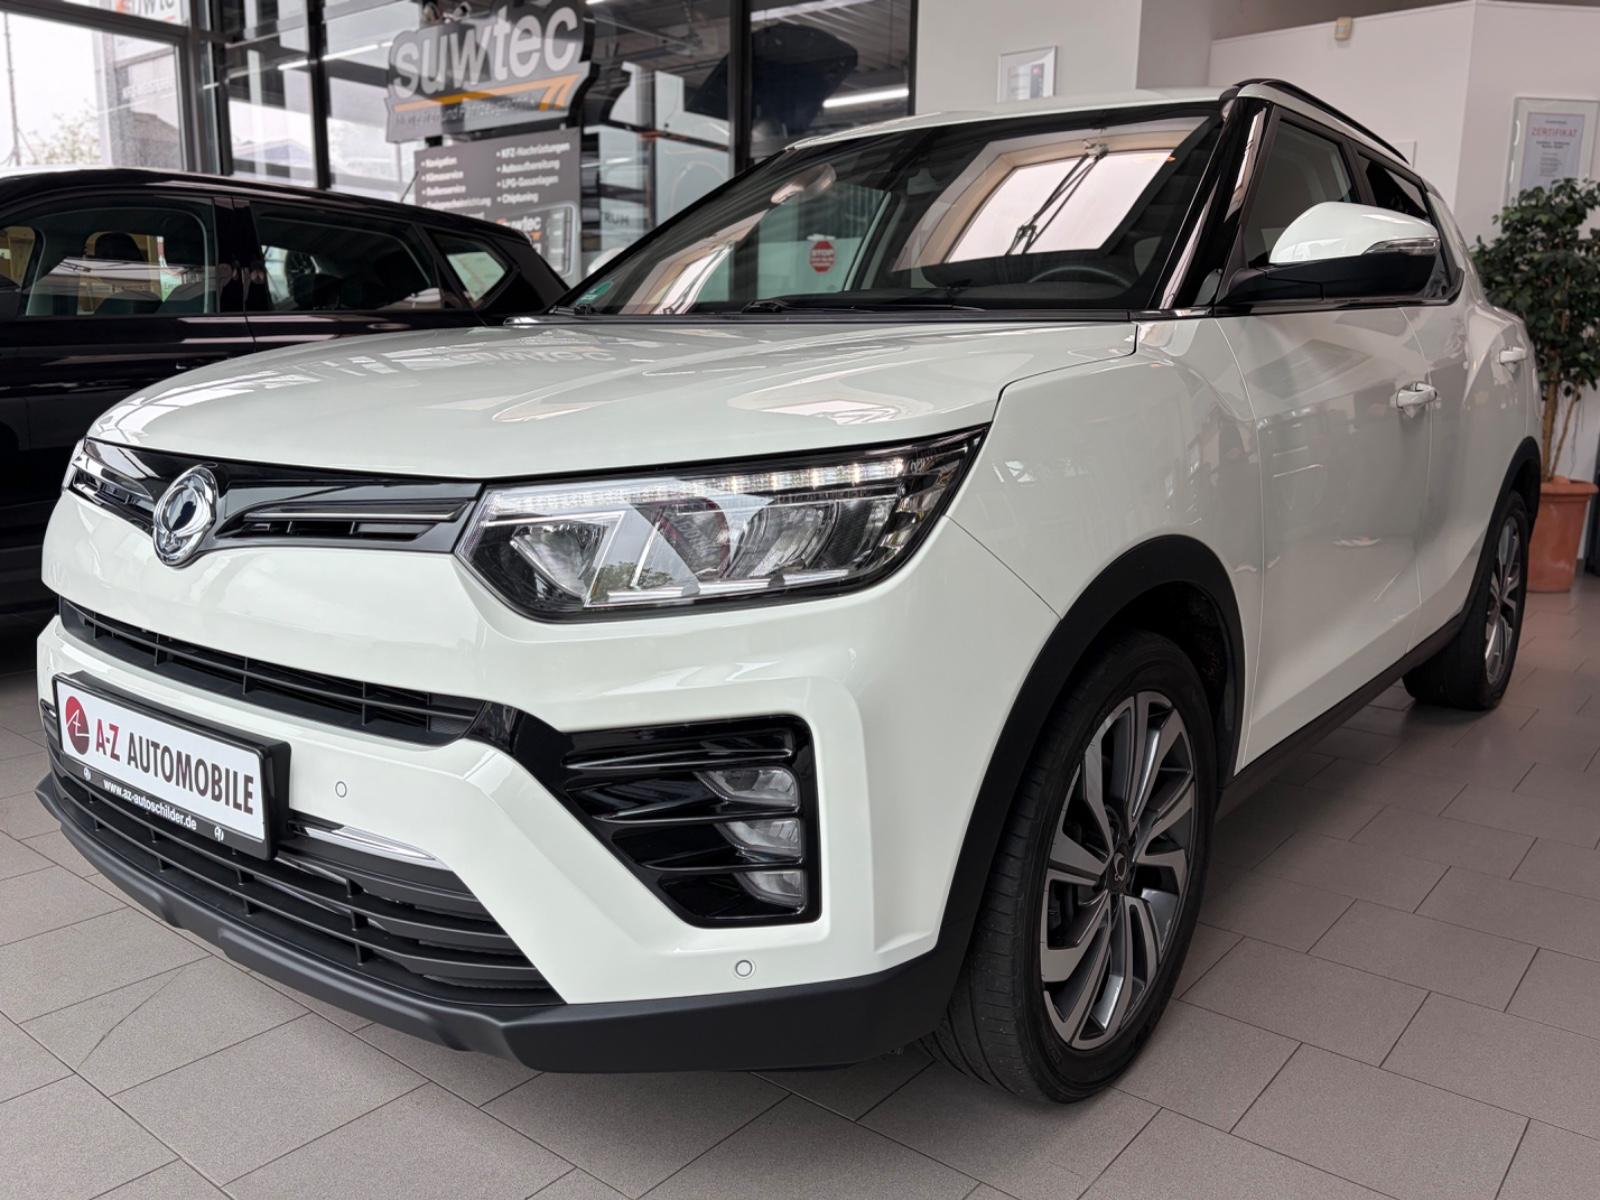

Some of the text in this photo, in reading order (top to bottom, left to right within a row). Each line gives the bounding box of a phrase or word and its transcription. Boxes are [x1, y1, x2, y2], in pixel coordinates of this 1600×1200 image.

[394, 6, 577, 98] suwtec
[1531, 126, 1578, 137] ZERTIFIKAT
[502, 192, 538, 204] Chiptuning
[811, 248, 834, 257] STOP
[95, 718, 121, 762] A-Z
[127, 731, 254, 815] AUTOMOBILE
[103, 780, 197, 830] www.az-autoschilder.de
